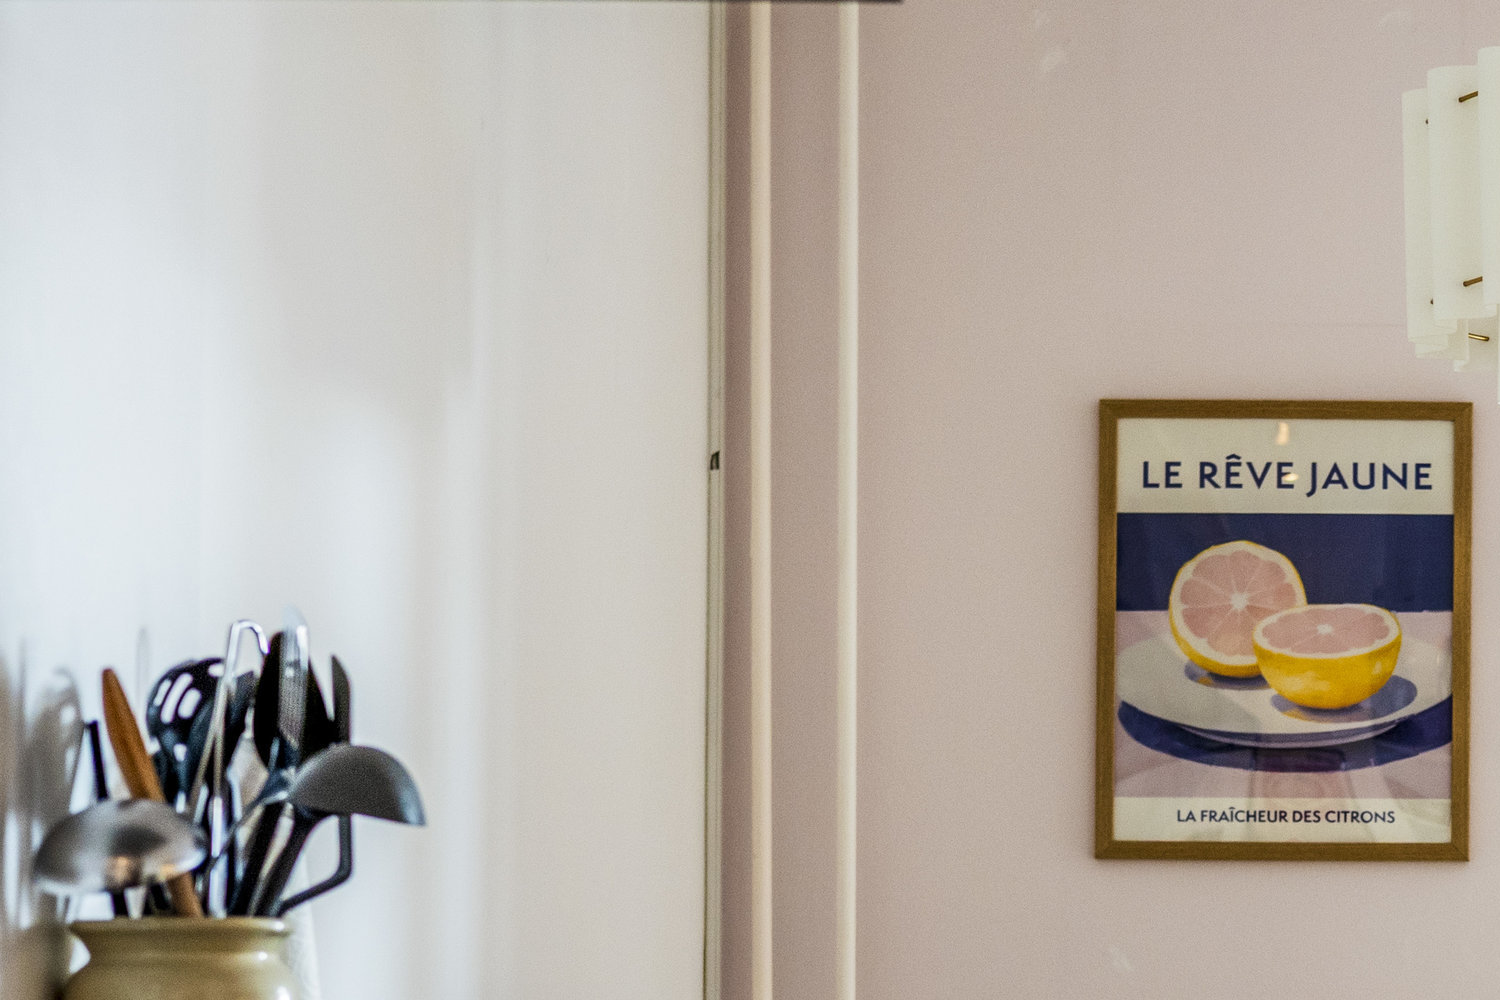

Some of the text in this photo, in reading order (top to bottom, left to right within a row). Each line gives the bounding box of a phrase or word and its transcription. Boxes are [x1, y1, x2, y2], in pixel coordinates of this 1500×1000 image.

[1142, 452, 1433, 498] LE RÊVE JAUNE
[1176, 806, 1396, 824] LA FRAÎCHEUR DES CITRONS
